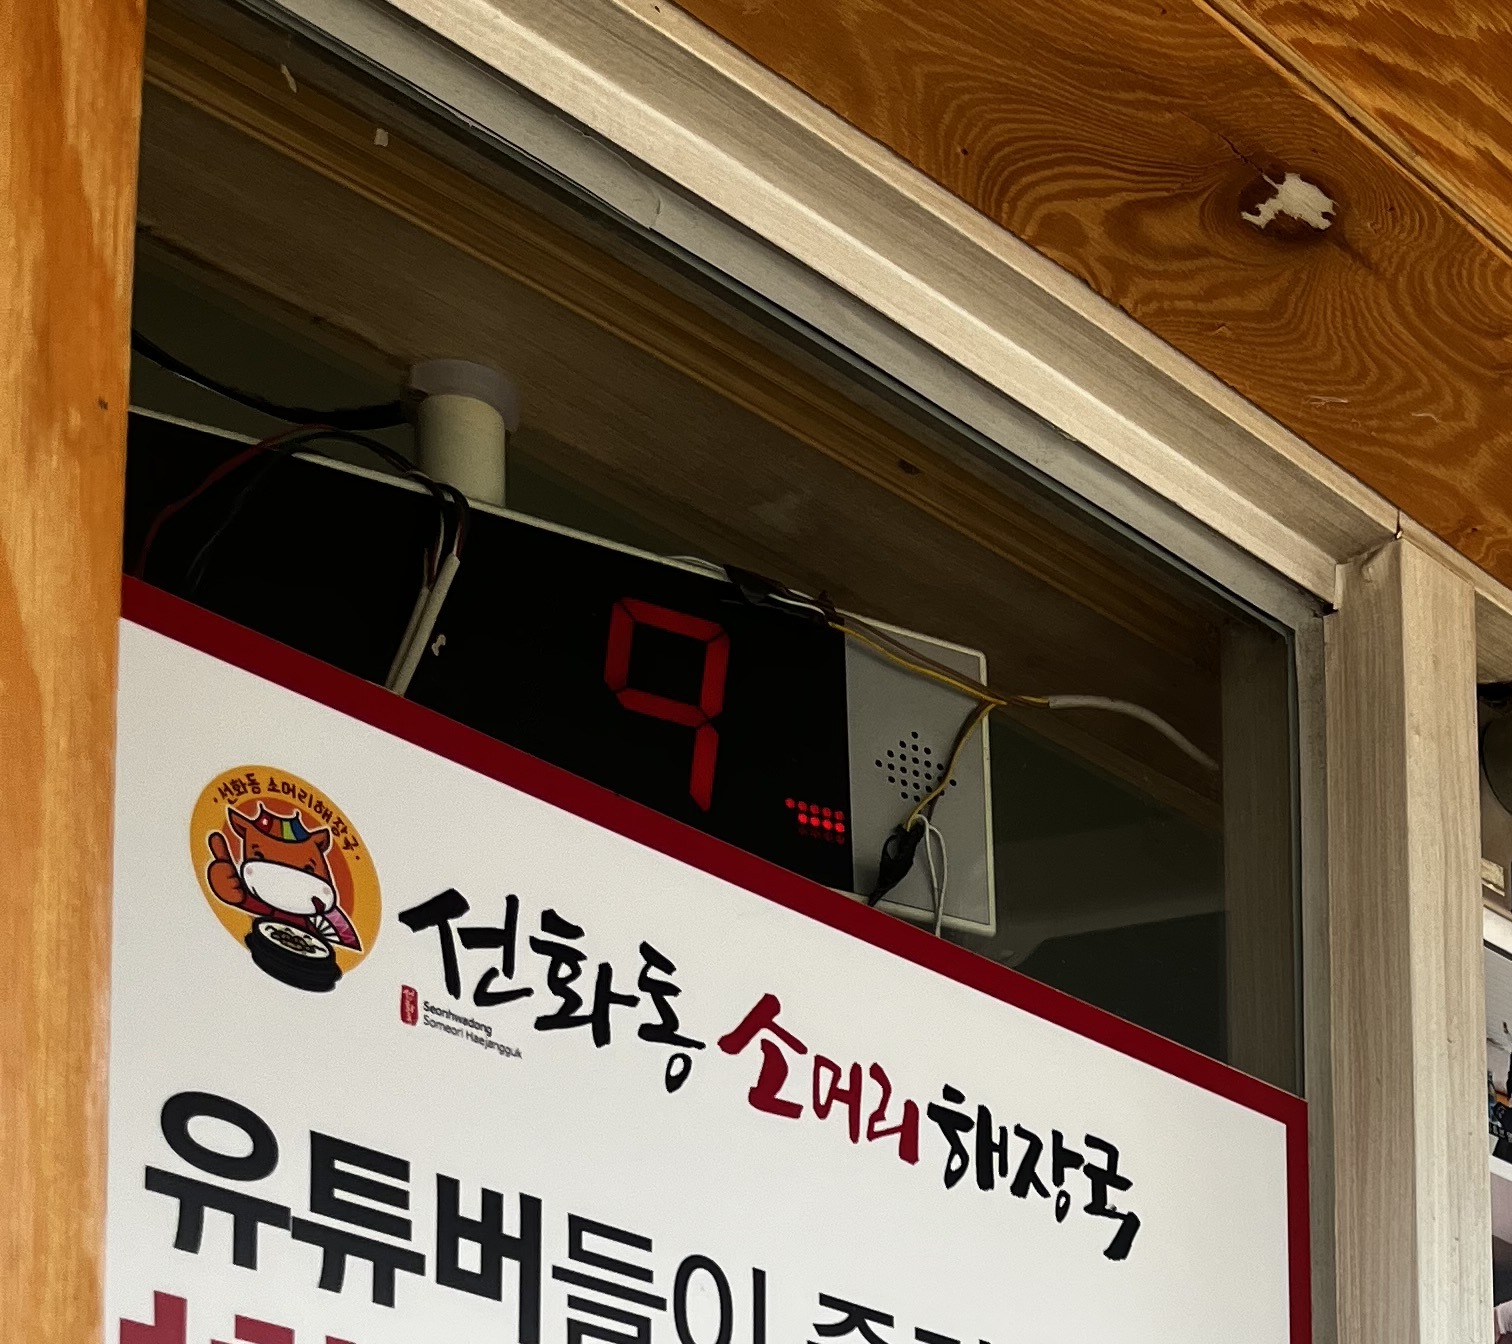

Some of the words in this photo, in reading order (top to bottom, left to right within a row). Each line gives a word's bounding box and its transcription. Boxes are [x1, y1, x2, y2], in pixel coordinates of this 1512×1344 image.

[604, 597, 730, 812] 9
[218, 773, 262, 805] 선화동
[267, 776, 359, 852] 소머리해장국
[398, 888, 706, 1094] 선화동
[719, 993, 918, 1164] 소머리
[927, 1084, 1141, 1261] 해장국
[423, 1001, 492, 1038] Seonhwadong
